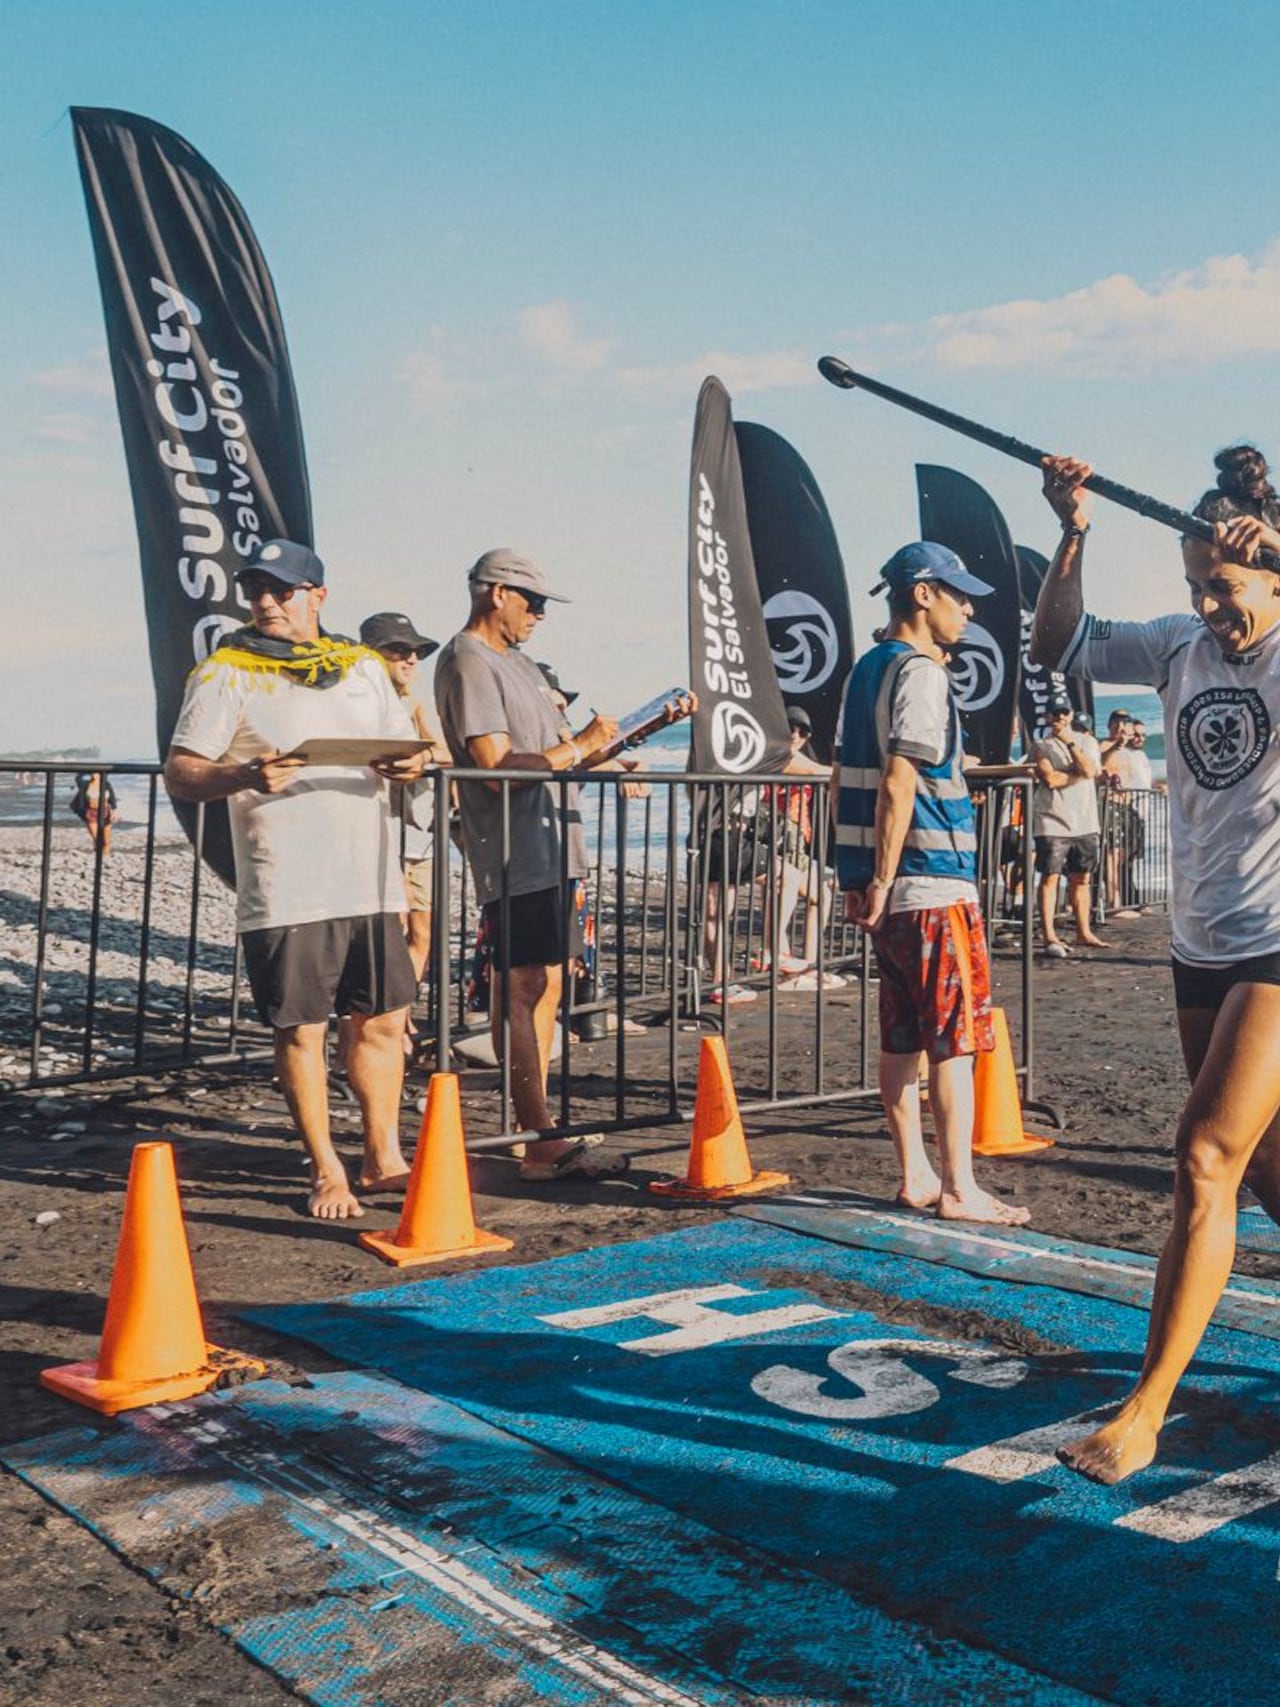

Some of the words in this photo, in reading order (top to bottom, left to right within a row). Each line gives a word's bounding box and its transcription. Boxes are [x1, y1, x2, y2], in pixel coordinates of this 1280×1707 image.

[146, 276, 209, 433] City
[158, 439, 229, 603] Surf
[208, 357, 264, 558] Salvador
[697, 472, 716, 577] City
[698, 578, 730, 694] Surf
[714, 531, 745, 665] Salvador
[728, 669, 753, 699] El
